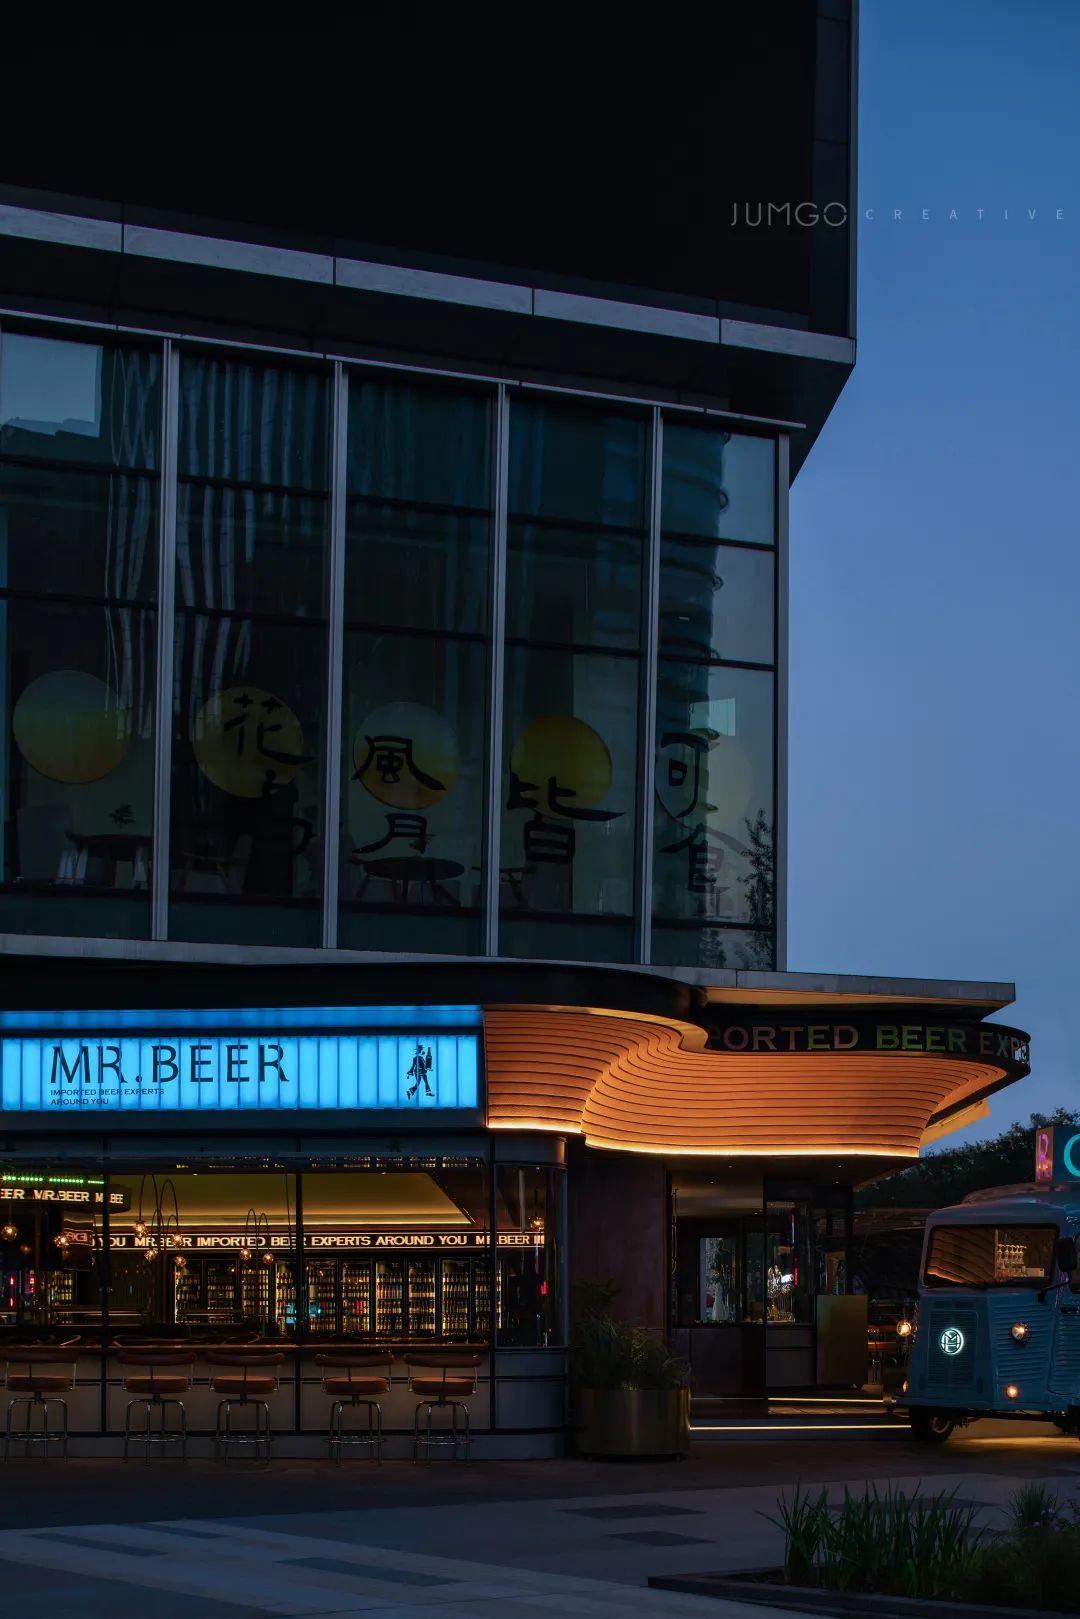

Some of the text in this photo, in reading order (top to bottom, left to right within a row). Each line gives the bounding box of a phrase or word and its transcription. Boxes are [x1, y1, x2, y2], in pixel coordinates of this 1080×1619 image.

[876, 1025, 968, 1053] BEER
[50, 1044, 290, 1083] MR.BEER
[197, 1237, 266, 1247] IMPORTED
[311, 1236, 371, 1246] EXPERTS
[375, 1236, 434, 1246] AROUND
[439, 1236, 467, 1245] YOU
